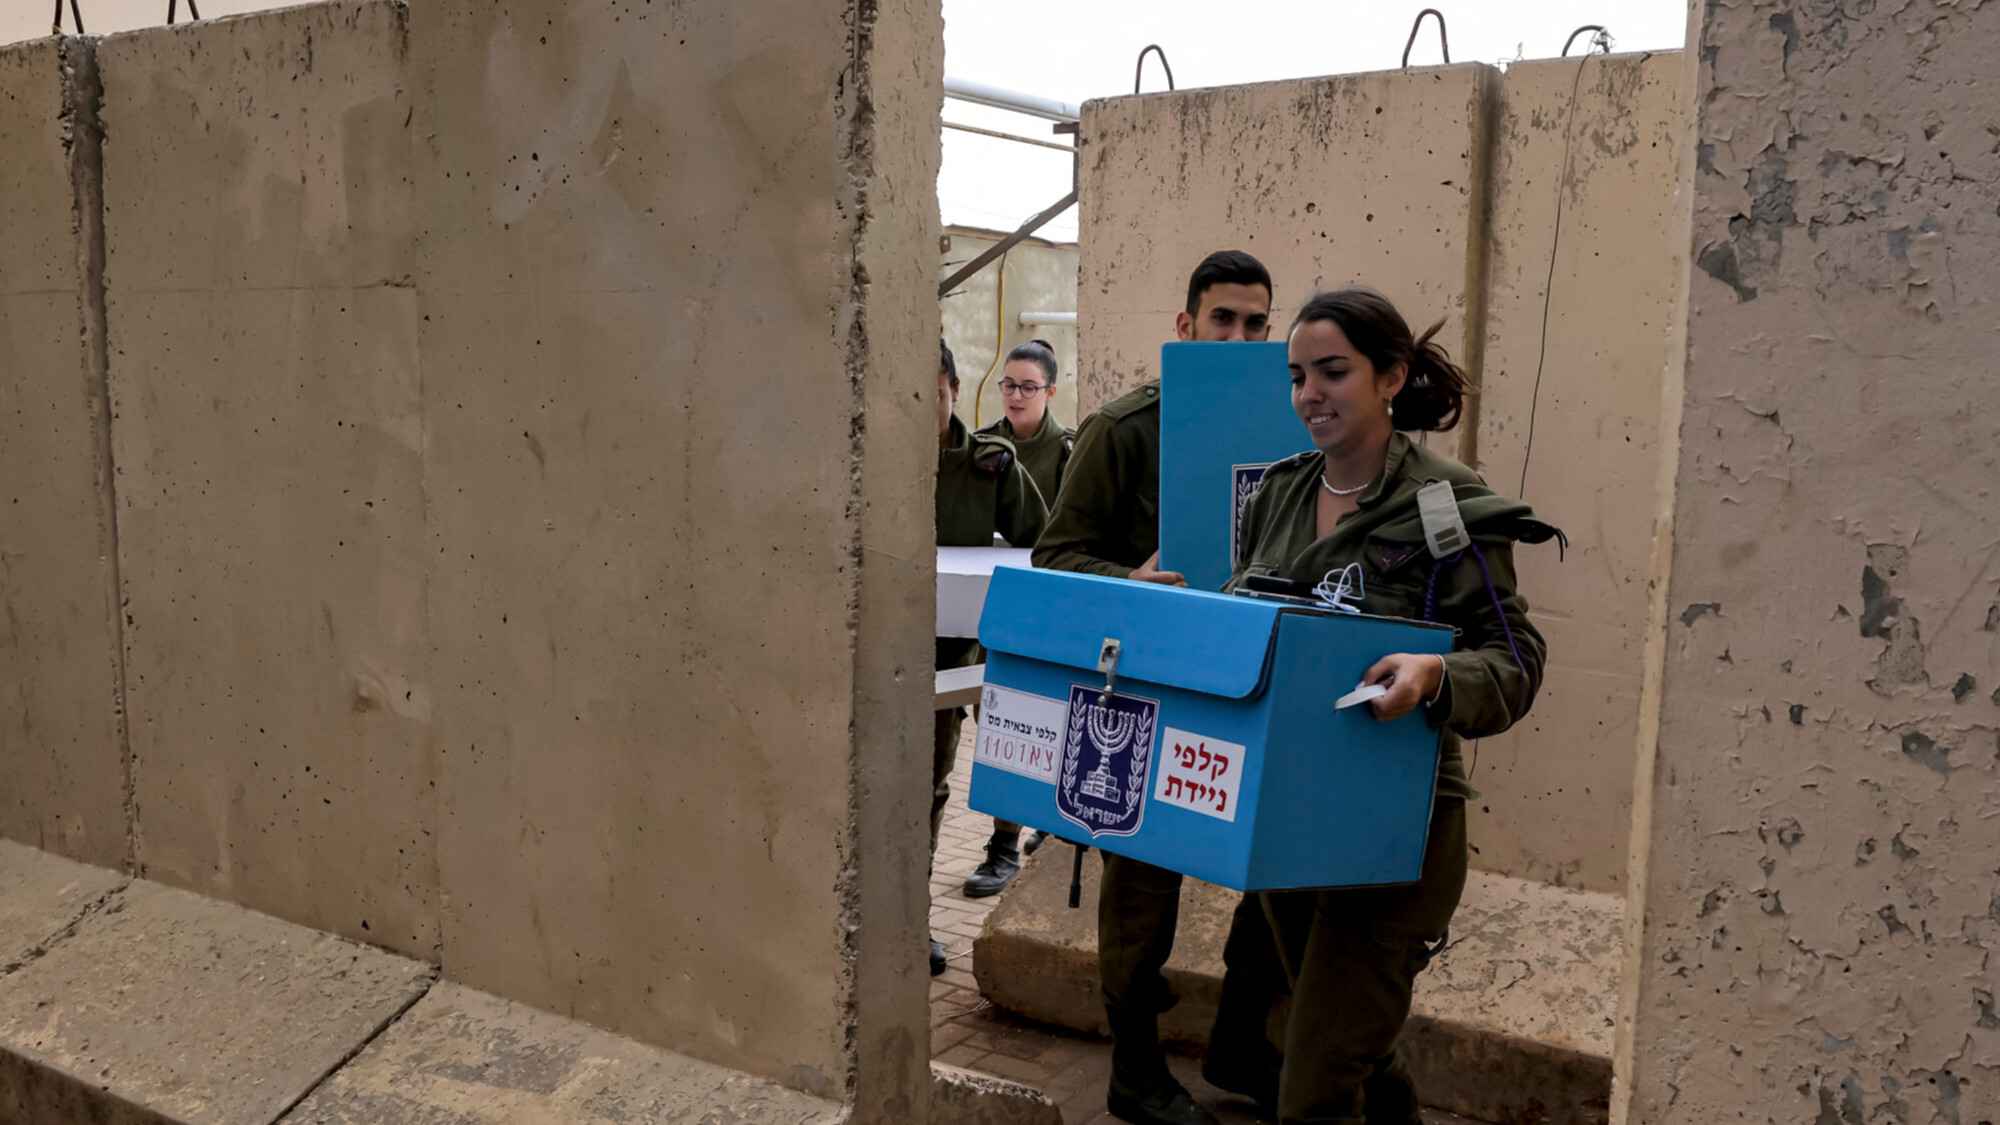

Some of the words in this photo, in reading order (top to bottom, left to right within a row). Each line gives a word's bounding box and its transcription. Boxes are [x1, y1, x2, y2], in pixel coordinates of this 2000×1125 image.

[1003, 718, 1033, 735] צבאית
[1035, 726, 1057, 743] קלפי
[1174, 742, 1229, 782] קלפי
[1074, 793, 1122, 825] ישראל
[1164, 774, 1227, 812] ניידת
